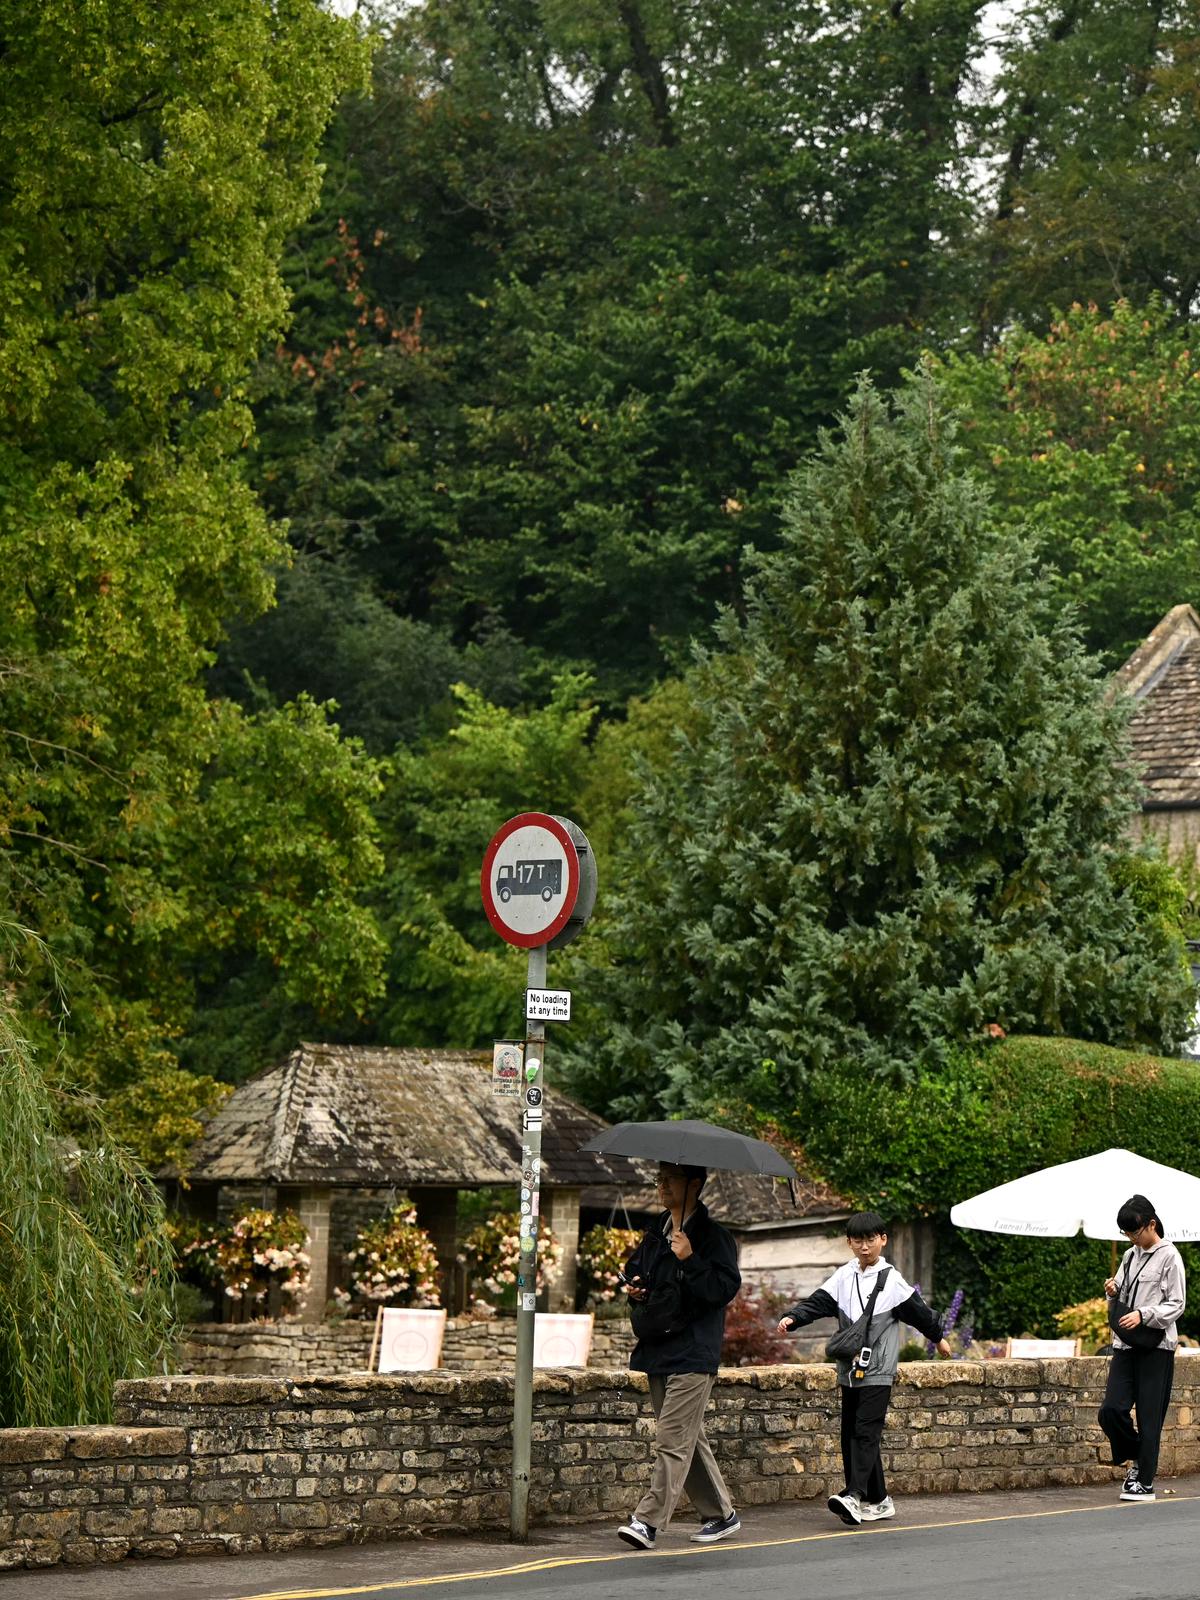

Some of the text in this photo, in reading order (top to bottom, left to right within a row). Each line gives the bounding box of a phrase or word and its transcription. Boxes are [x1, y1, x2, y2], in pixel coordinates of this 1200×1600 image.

[530, 993, 568, 1006] No loading
[529, 1005, 568, 1017] at any time
[993, 1219, 1049, 1233] Laurent Perrier
